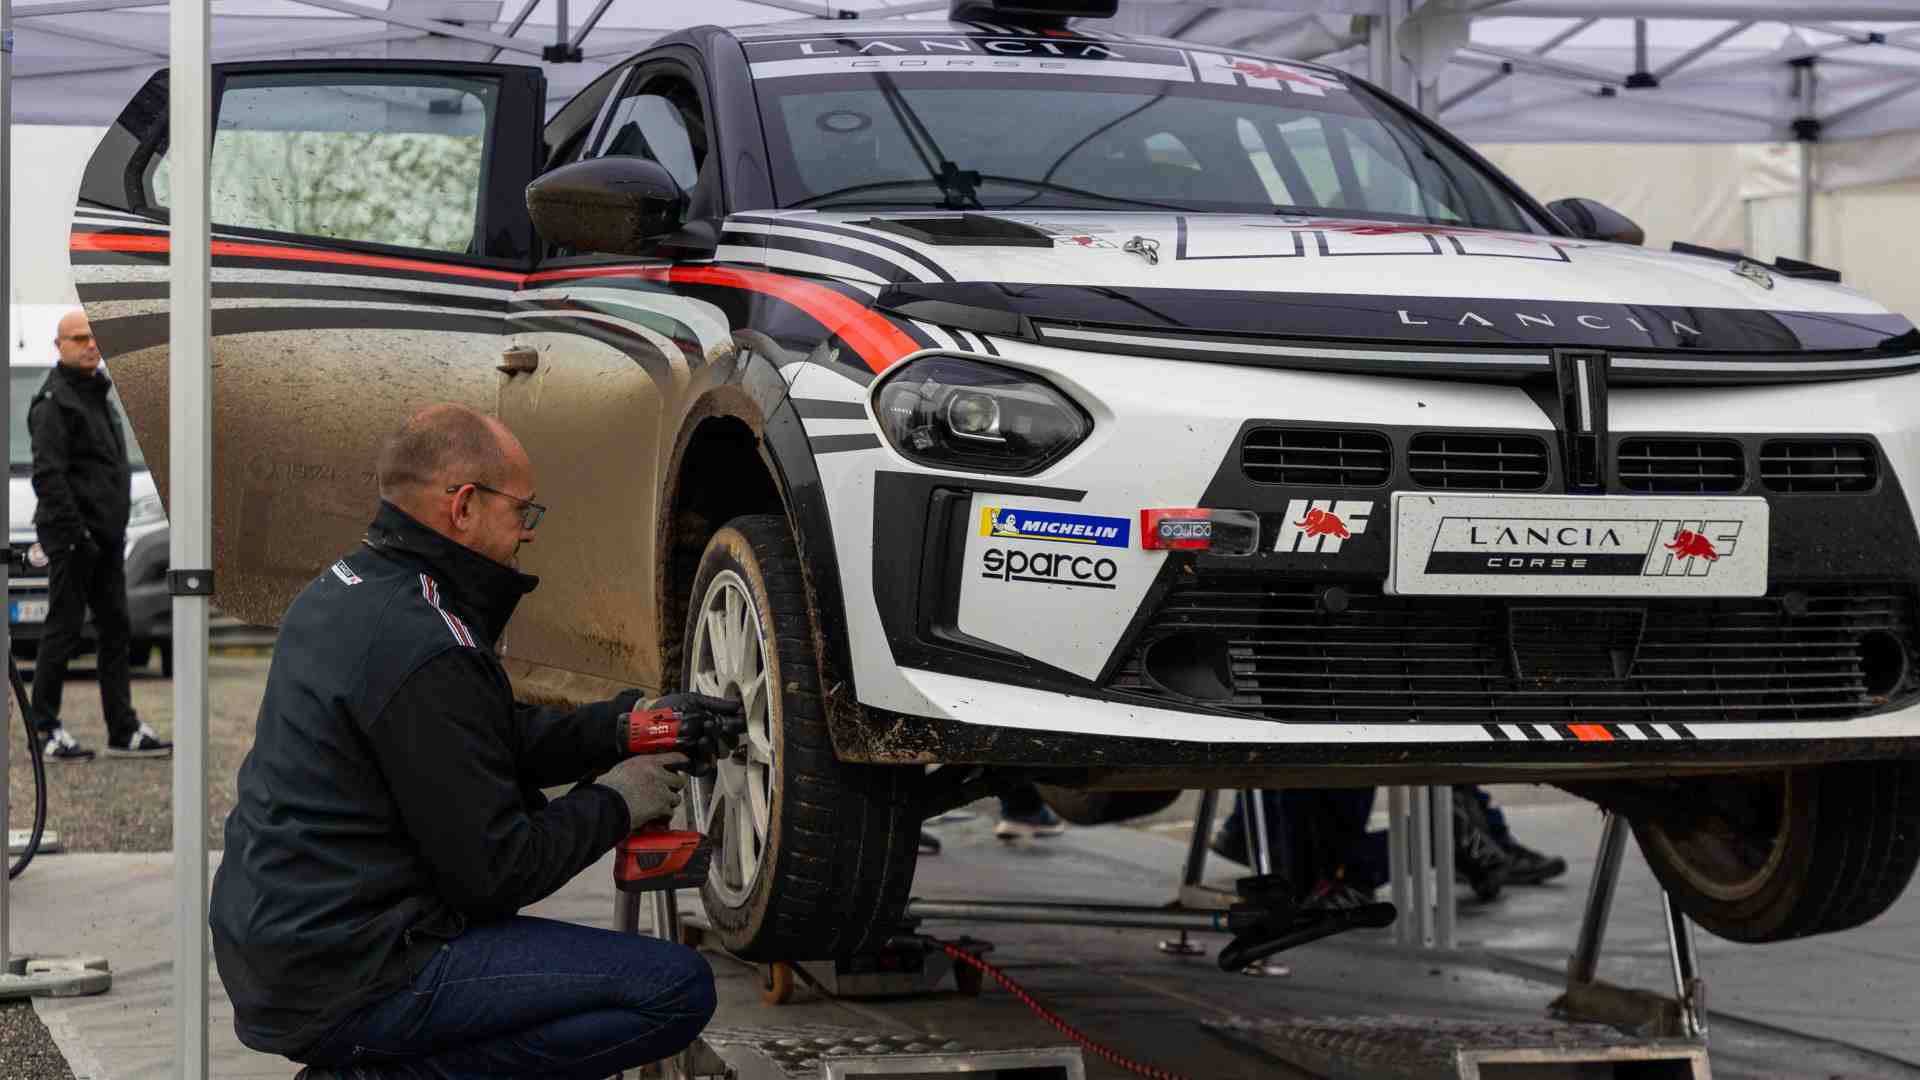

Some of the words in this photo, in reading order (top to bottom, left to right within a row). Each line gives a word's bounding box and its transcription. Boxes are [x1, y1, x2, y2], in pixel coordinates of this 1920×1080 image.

[799, 40, 1126, 58] LANCIA
[851, 59, 1067, 70] CORSE
[1397, 310, 1702, 335] LANCIA
[1021, 519, 1119, 539] MICHELIN
[1469, 525, 1622, 547] LANCIA
[982, 548, 1118, 583] sparco
[1487, 557, 1589, 569] CORSE
